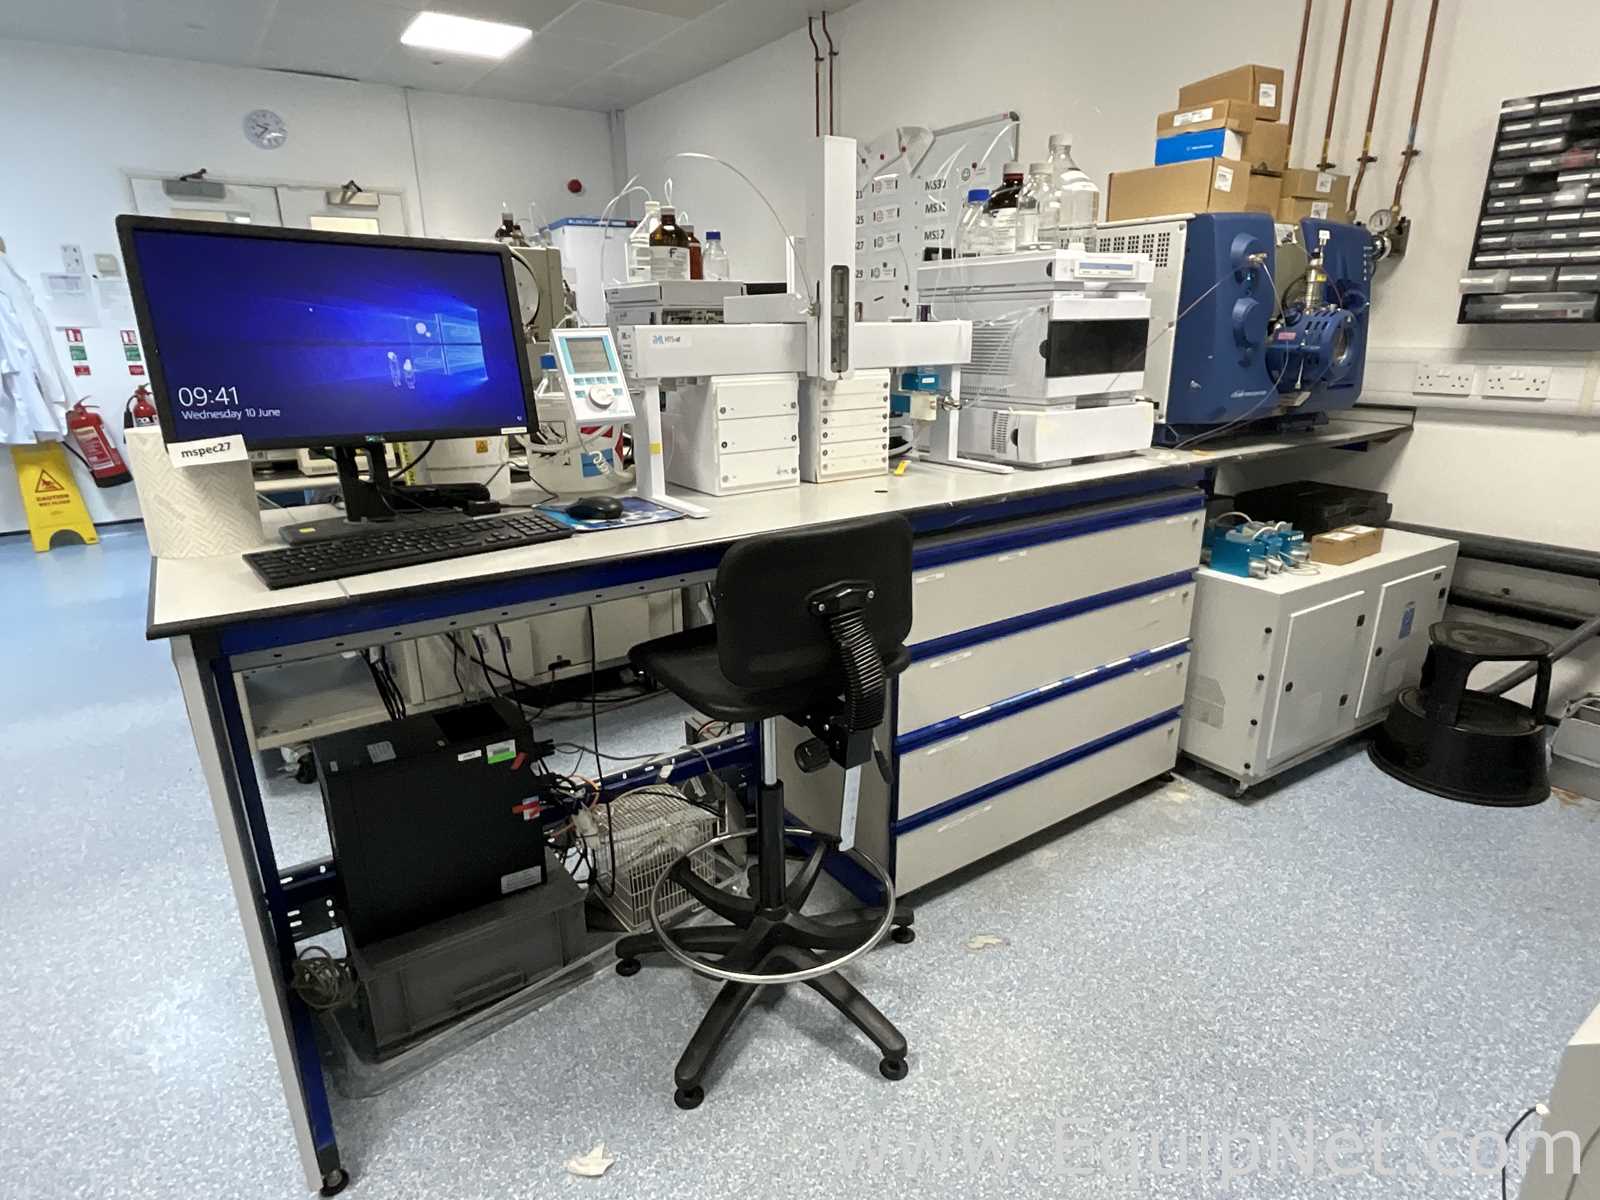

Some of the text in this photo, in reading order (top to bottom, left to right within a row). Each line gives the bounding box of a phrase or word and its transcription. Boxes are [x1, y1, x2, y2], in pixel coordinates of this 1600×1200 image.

[178, 386, 239, 407] 09:41
[181, 408, 281, 421] Wednesday 10 June
[181, 442, 232, 458] mspec27
